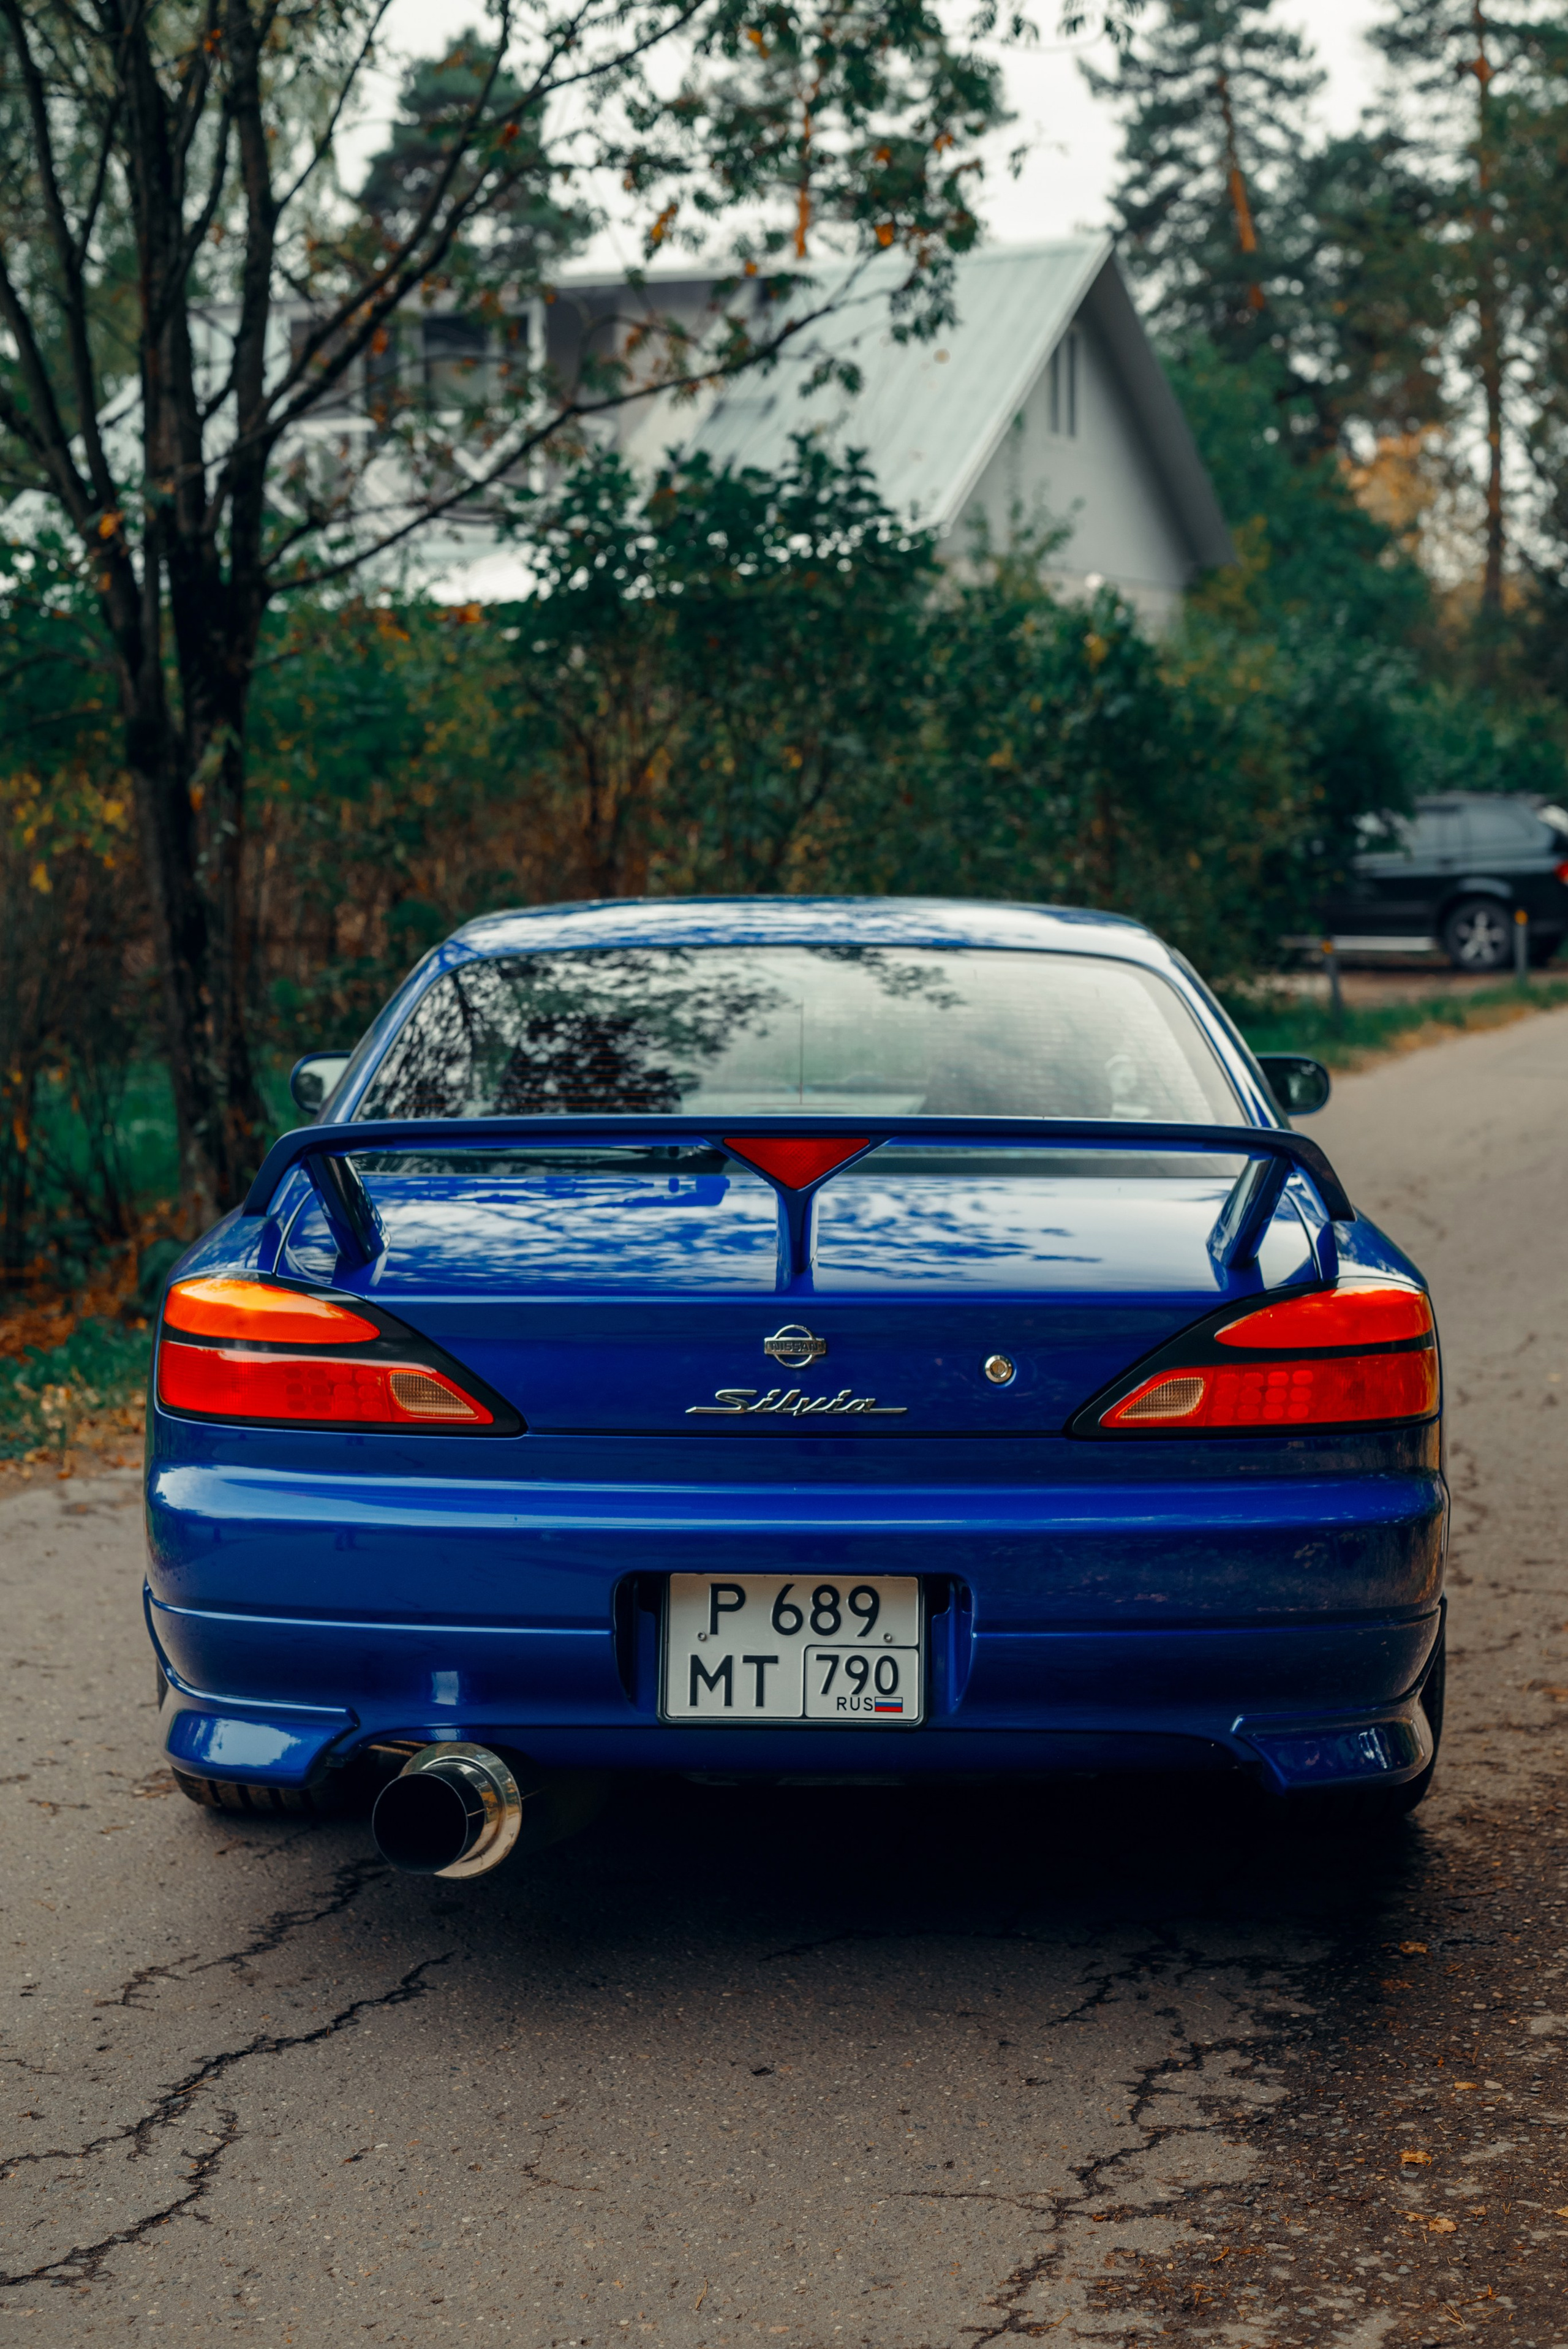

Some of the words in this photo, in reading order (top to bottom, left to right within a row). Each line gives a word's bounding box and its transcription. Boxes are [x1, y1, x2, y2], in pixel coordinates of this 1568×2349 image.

[771, 1341, 819, 1352] NISSAN
[685, 1389, 907, 1416] Silvia
[772, 1583, 880, 1637] 689
[816, 1654, 899, 1695] 790
[837, 1697, 873, 1711] RUS
